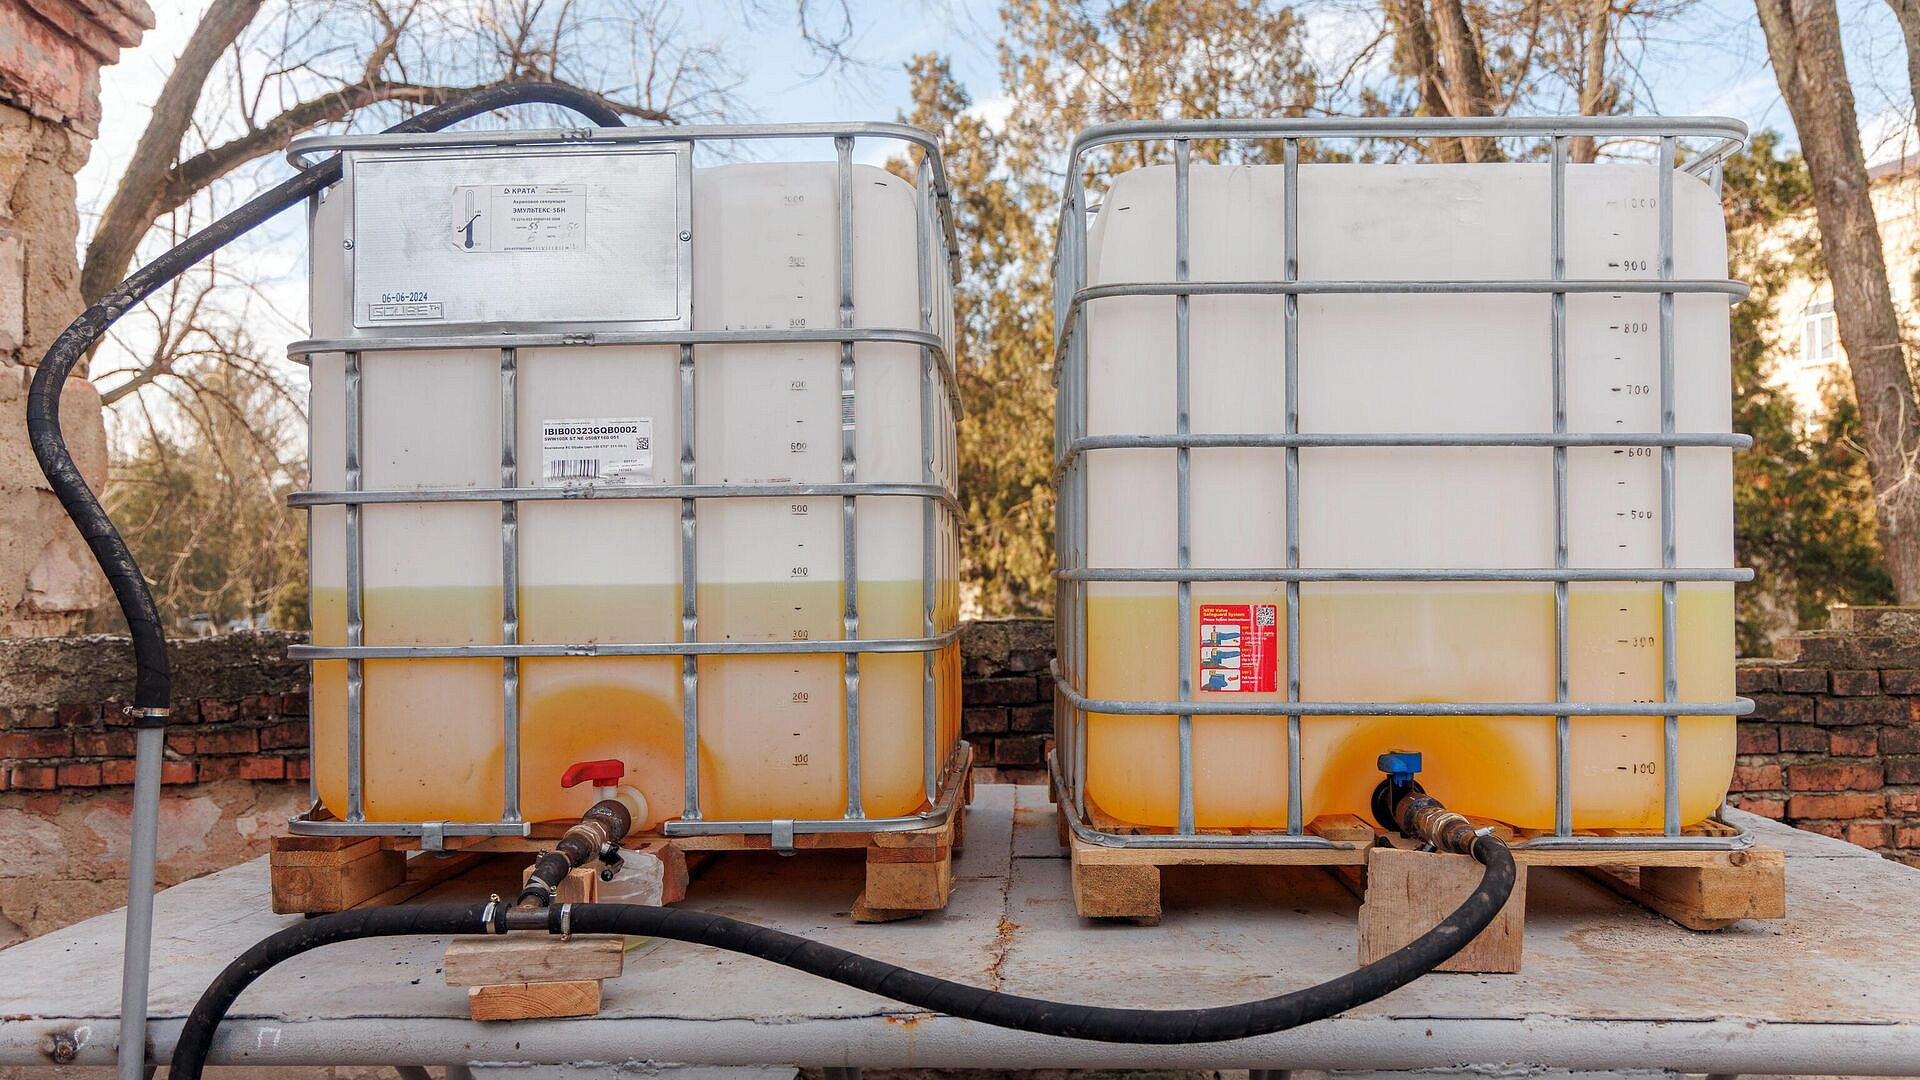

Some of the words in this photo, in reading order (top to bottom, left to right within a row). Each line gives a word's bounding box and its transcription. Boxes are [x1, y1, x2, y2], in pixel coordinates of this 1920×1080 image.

[1624, 260, 1647, 271] 900
[382, 292, 428, 303] 06-06-2024
[1624, 323, 1647, 334] 800
[1626, 384, 1649, 395] 700
[544, 426, 637, 435] IBIB00323GQB0002
[791, 442, 807, 450] 600
[791, 504, 808, 512] 500
[1631, 510, 1652, 519] 500
[791, 567, 808, 575] 400
[792, 630, 808, 638] 300
[792, 692, 808, 700] 200
[794, 754, 808, 763] 100
[1633, 761, 1656, 774] 100
